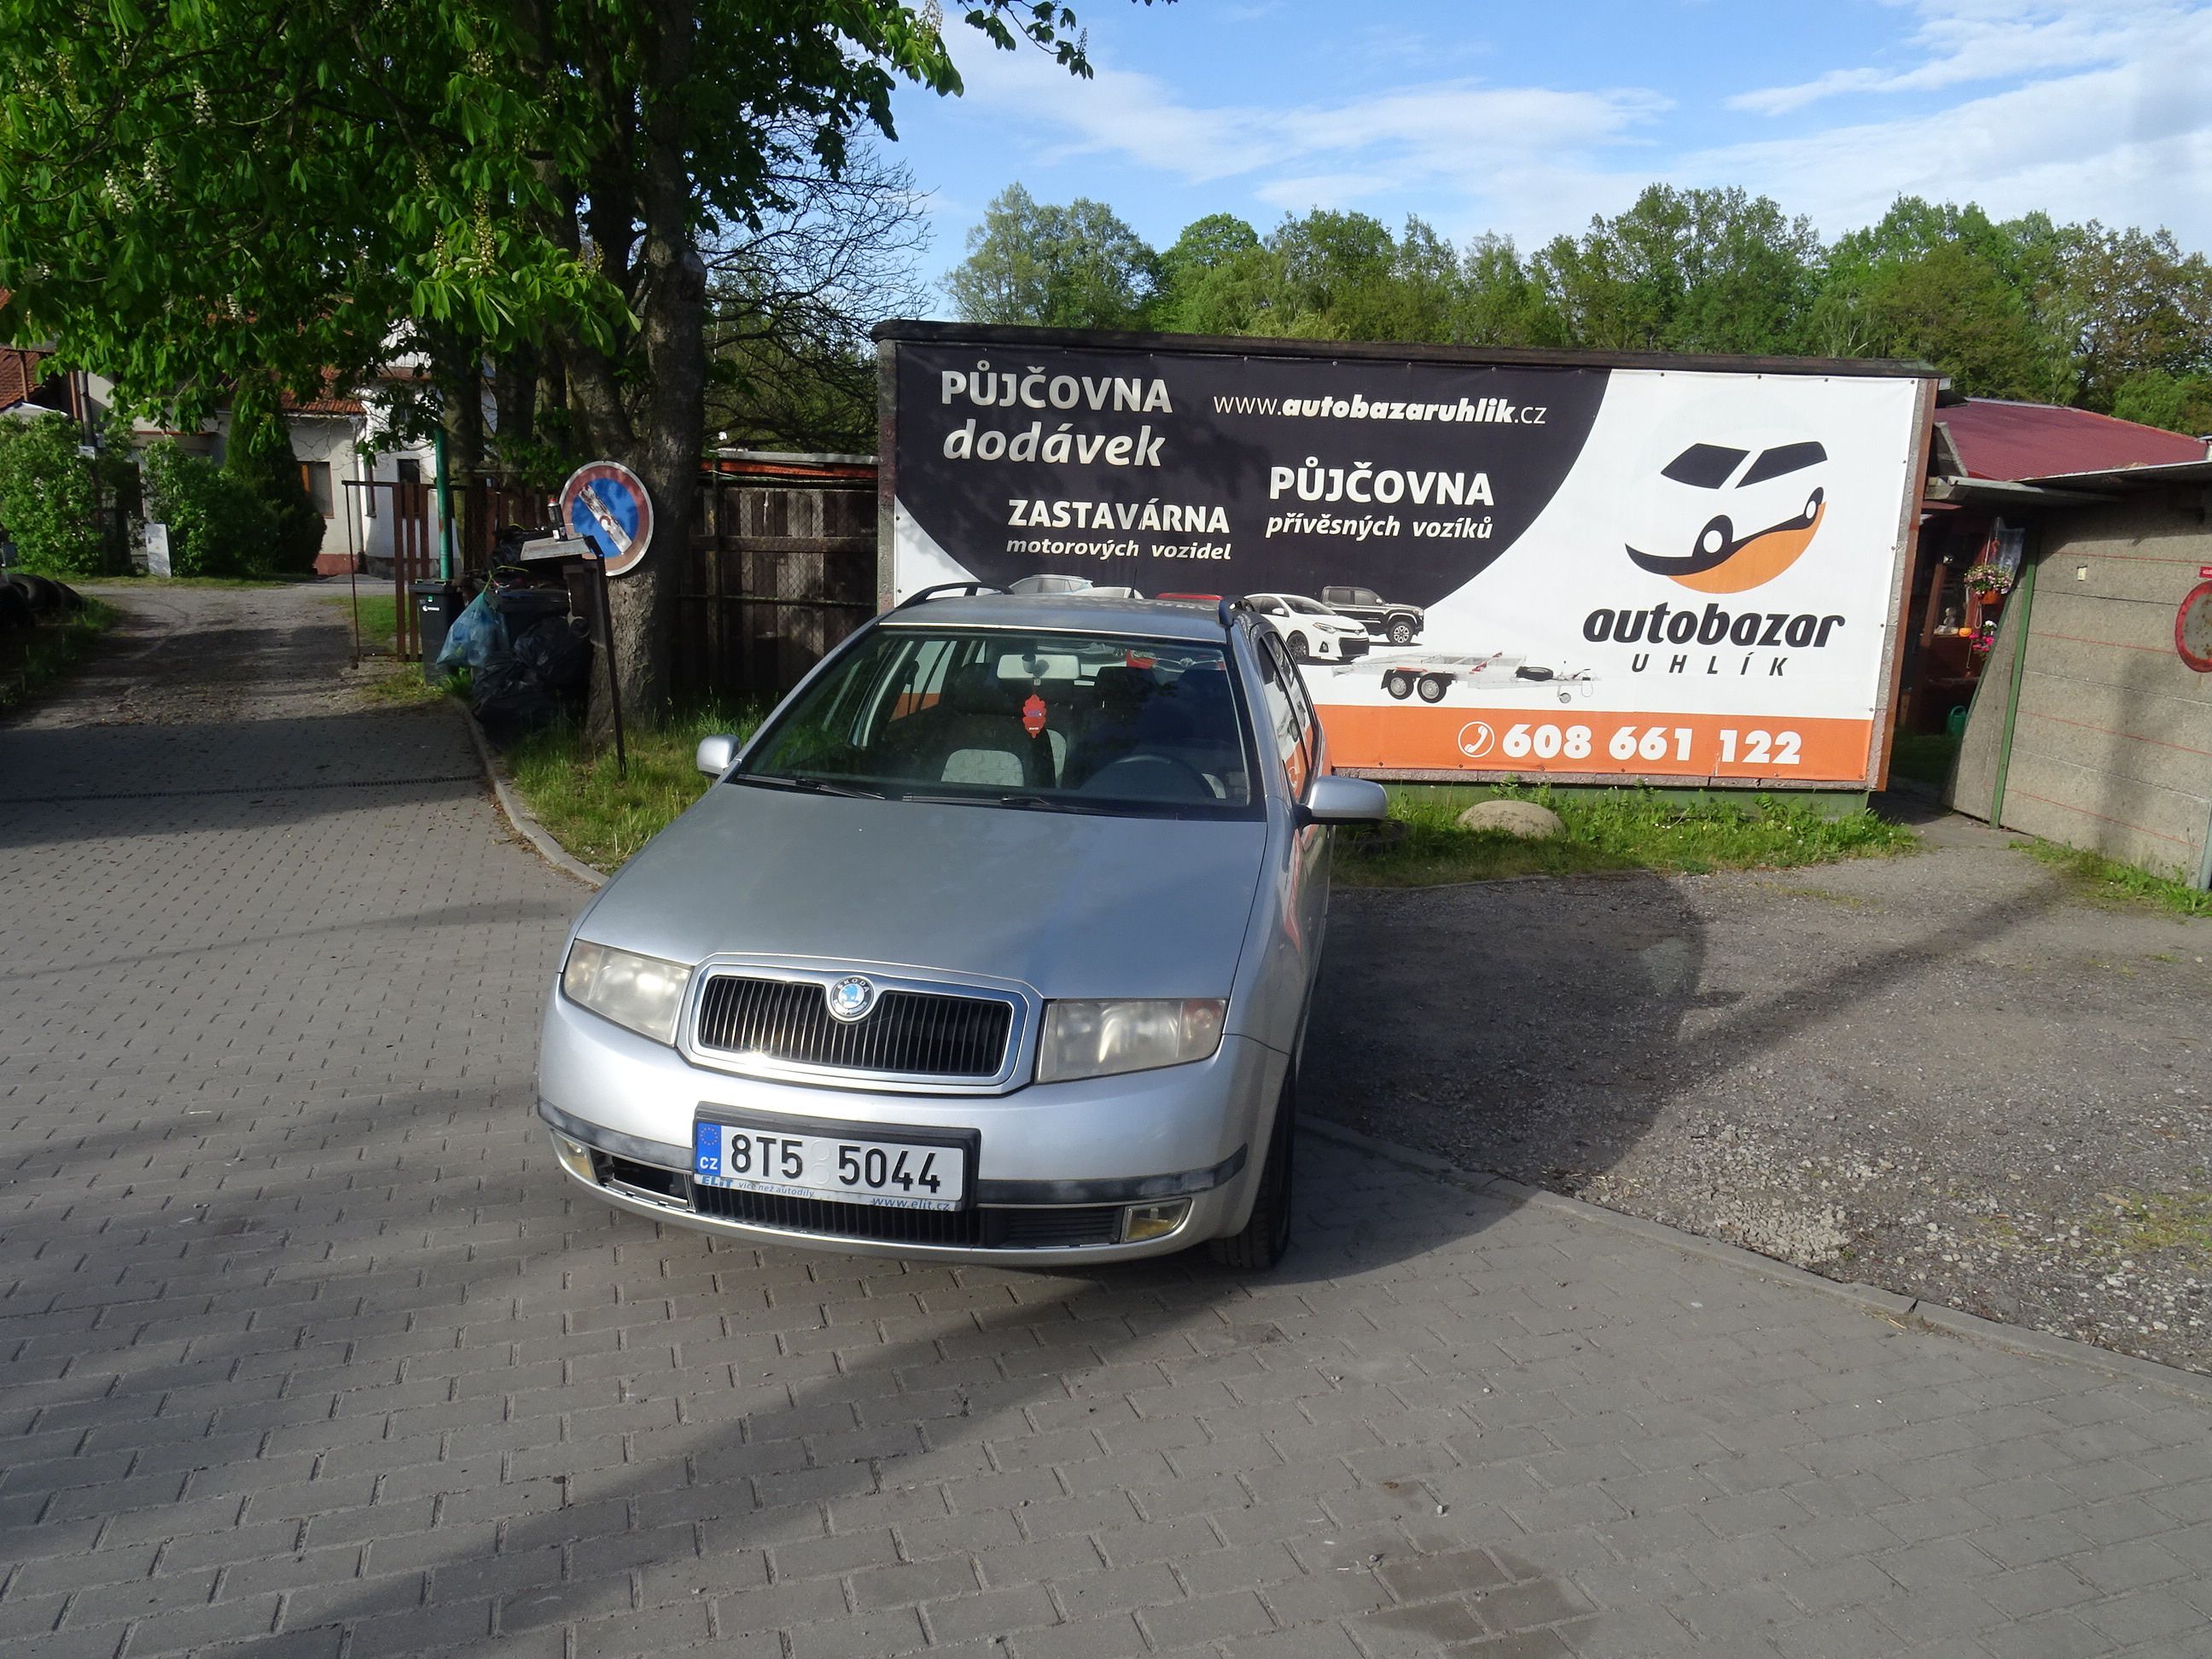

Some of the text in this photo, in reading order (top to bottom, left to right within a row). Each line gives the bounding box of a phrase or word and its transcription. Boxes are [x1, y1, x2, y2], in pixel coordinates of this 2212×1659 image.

[941, 359, 1173, 413] PŮJČOVNA
[1214, 394, 1547, 425] www.autobazaruhlik.cz
[943, 418, 1166, 466] dodávek
[1270, 456, 1494, 506] PŮJČOVNA
[1007, 498, 1231, 533] ZASTAVÁRNA
[1266, 512, 1493, 541] přívěsných vozíků
[1006, 537, 1231, 561] motorových vozidel
[1583, 602, 1845, 647] autobazar
[1632, 652, 1788, 676] UHLÍK
[1502, 724, 1802, 765] 608 661 122
[700, 1156, 718, 1170] CZ
[731, 1134, 940, 1194] 8T5 5044
[872, 1197, 950, 1211] www.elit.cz
